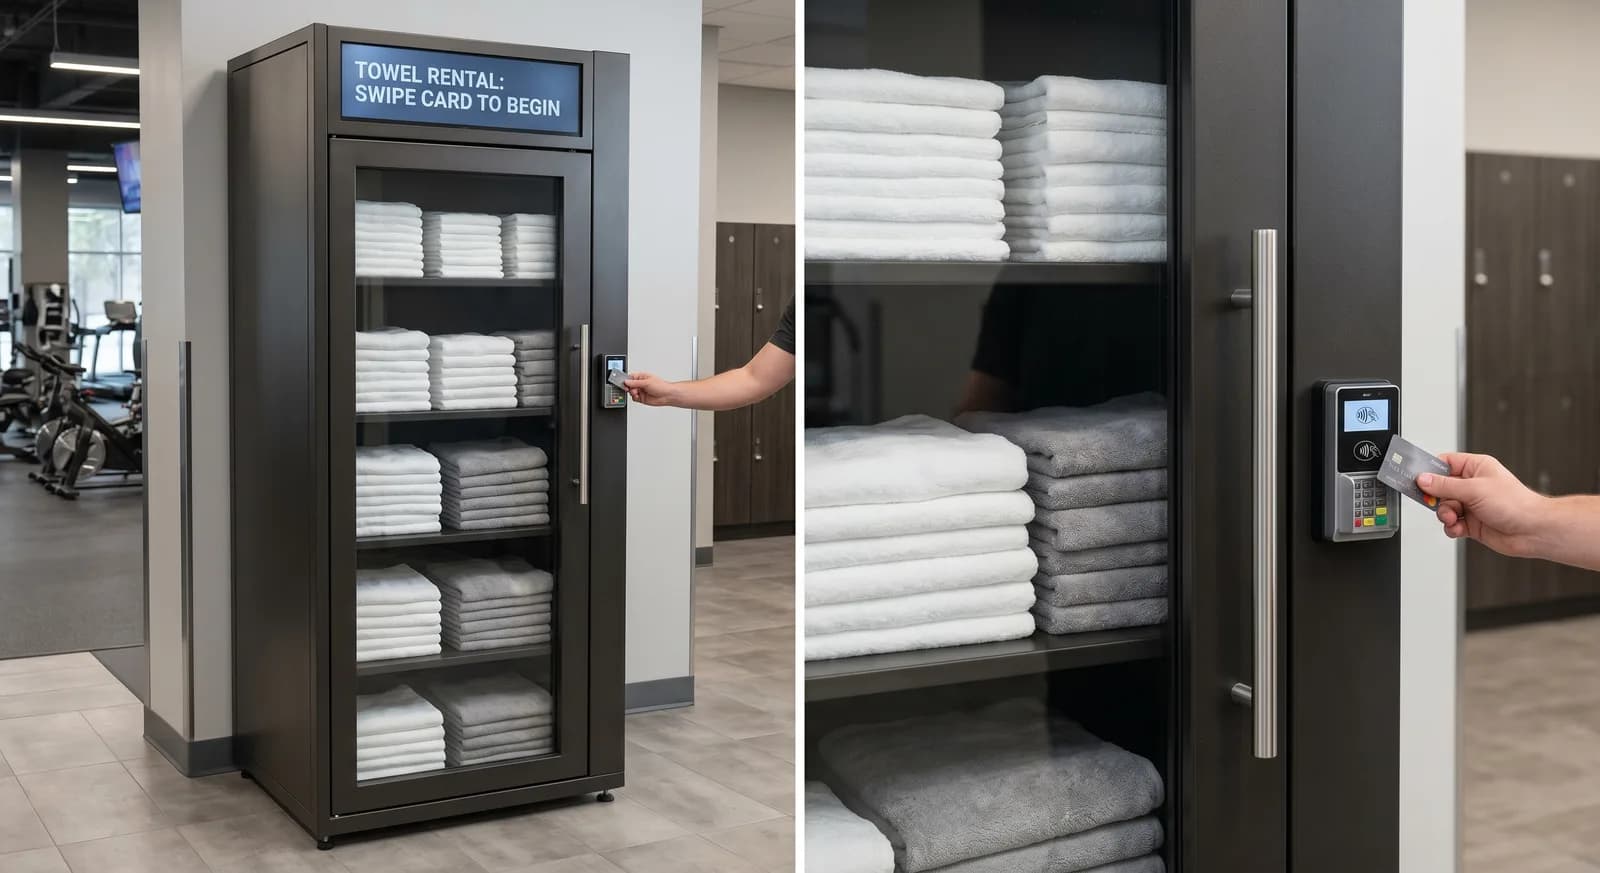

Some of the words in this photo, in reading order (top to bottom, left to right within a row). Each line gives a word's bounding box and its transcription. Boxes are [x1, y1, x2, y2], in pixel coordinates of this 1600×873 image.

[355, 61, 422, 83] TOWEL
[428, 67, 504, 90] RENTAL:
[355, 84, 416, 105] SWIPE
[421, 90, 472, 109] CARD
[477, 94, 501, 112] TO
[507, 97, 560, 117] BEGIN
